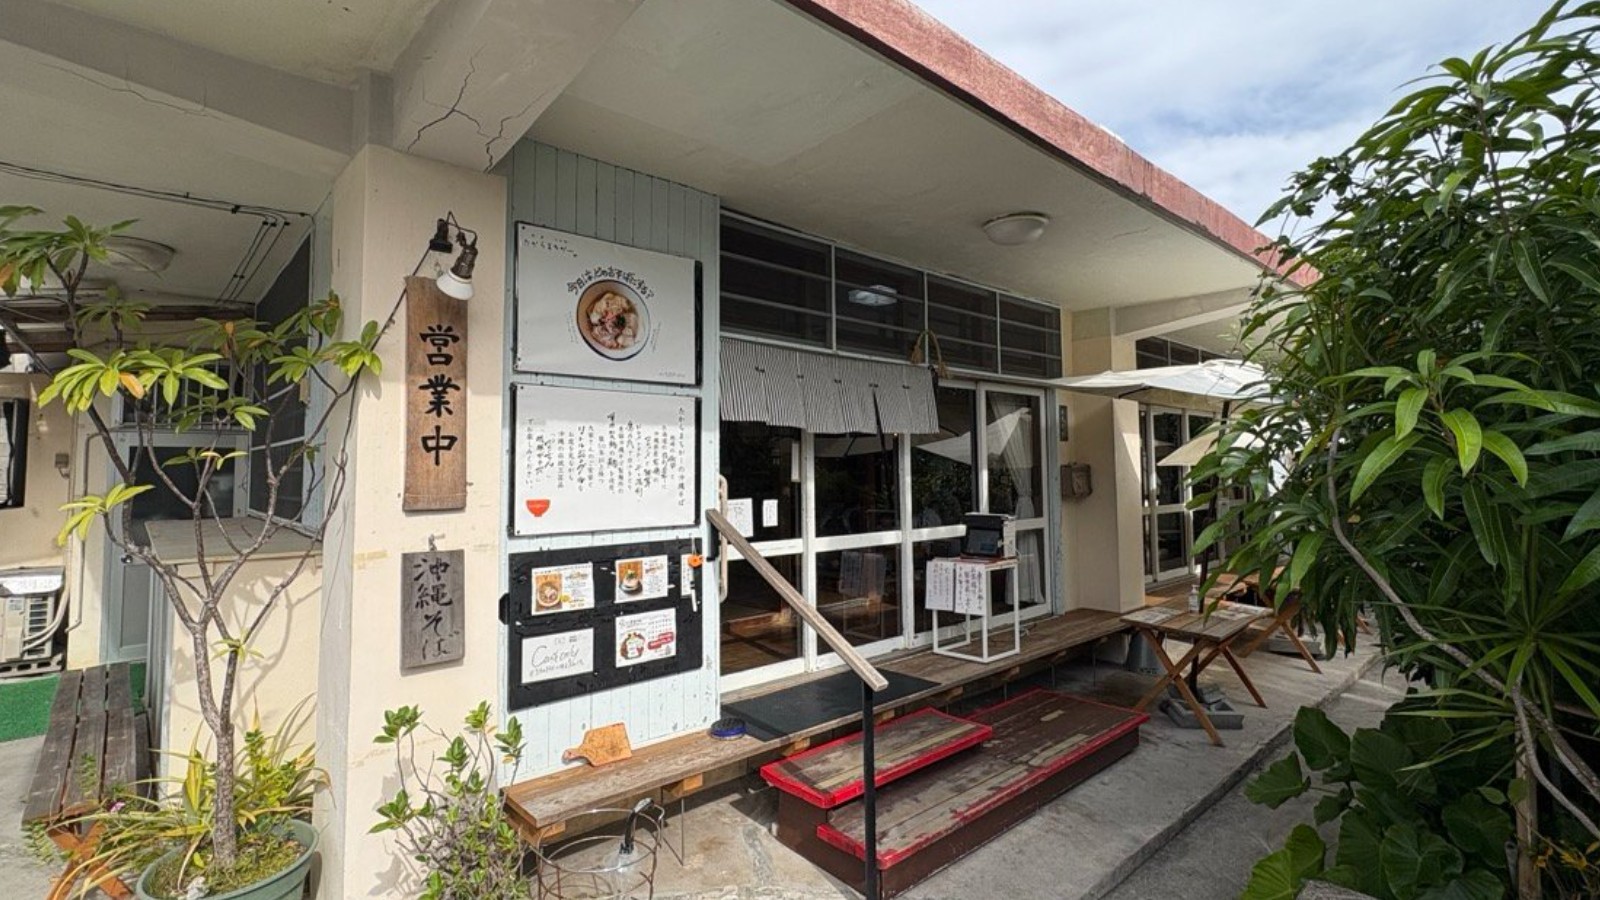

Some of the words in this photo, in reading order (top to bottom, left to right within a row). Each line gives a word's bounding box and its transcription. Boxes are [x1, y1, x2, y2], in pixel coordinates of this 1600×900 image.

[418, 323, 462, 467] 営業中
[412, 556, 460, 661] 沖縄そば
